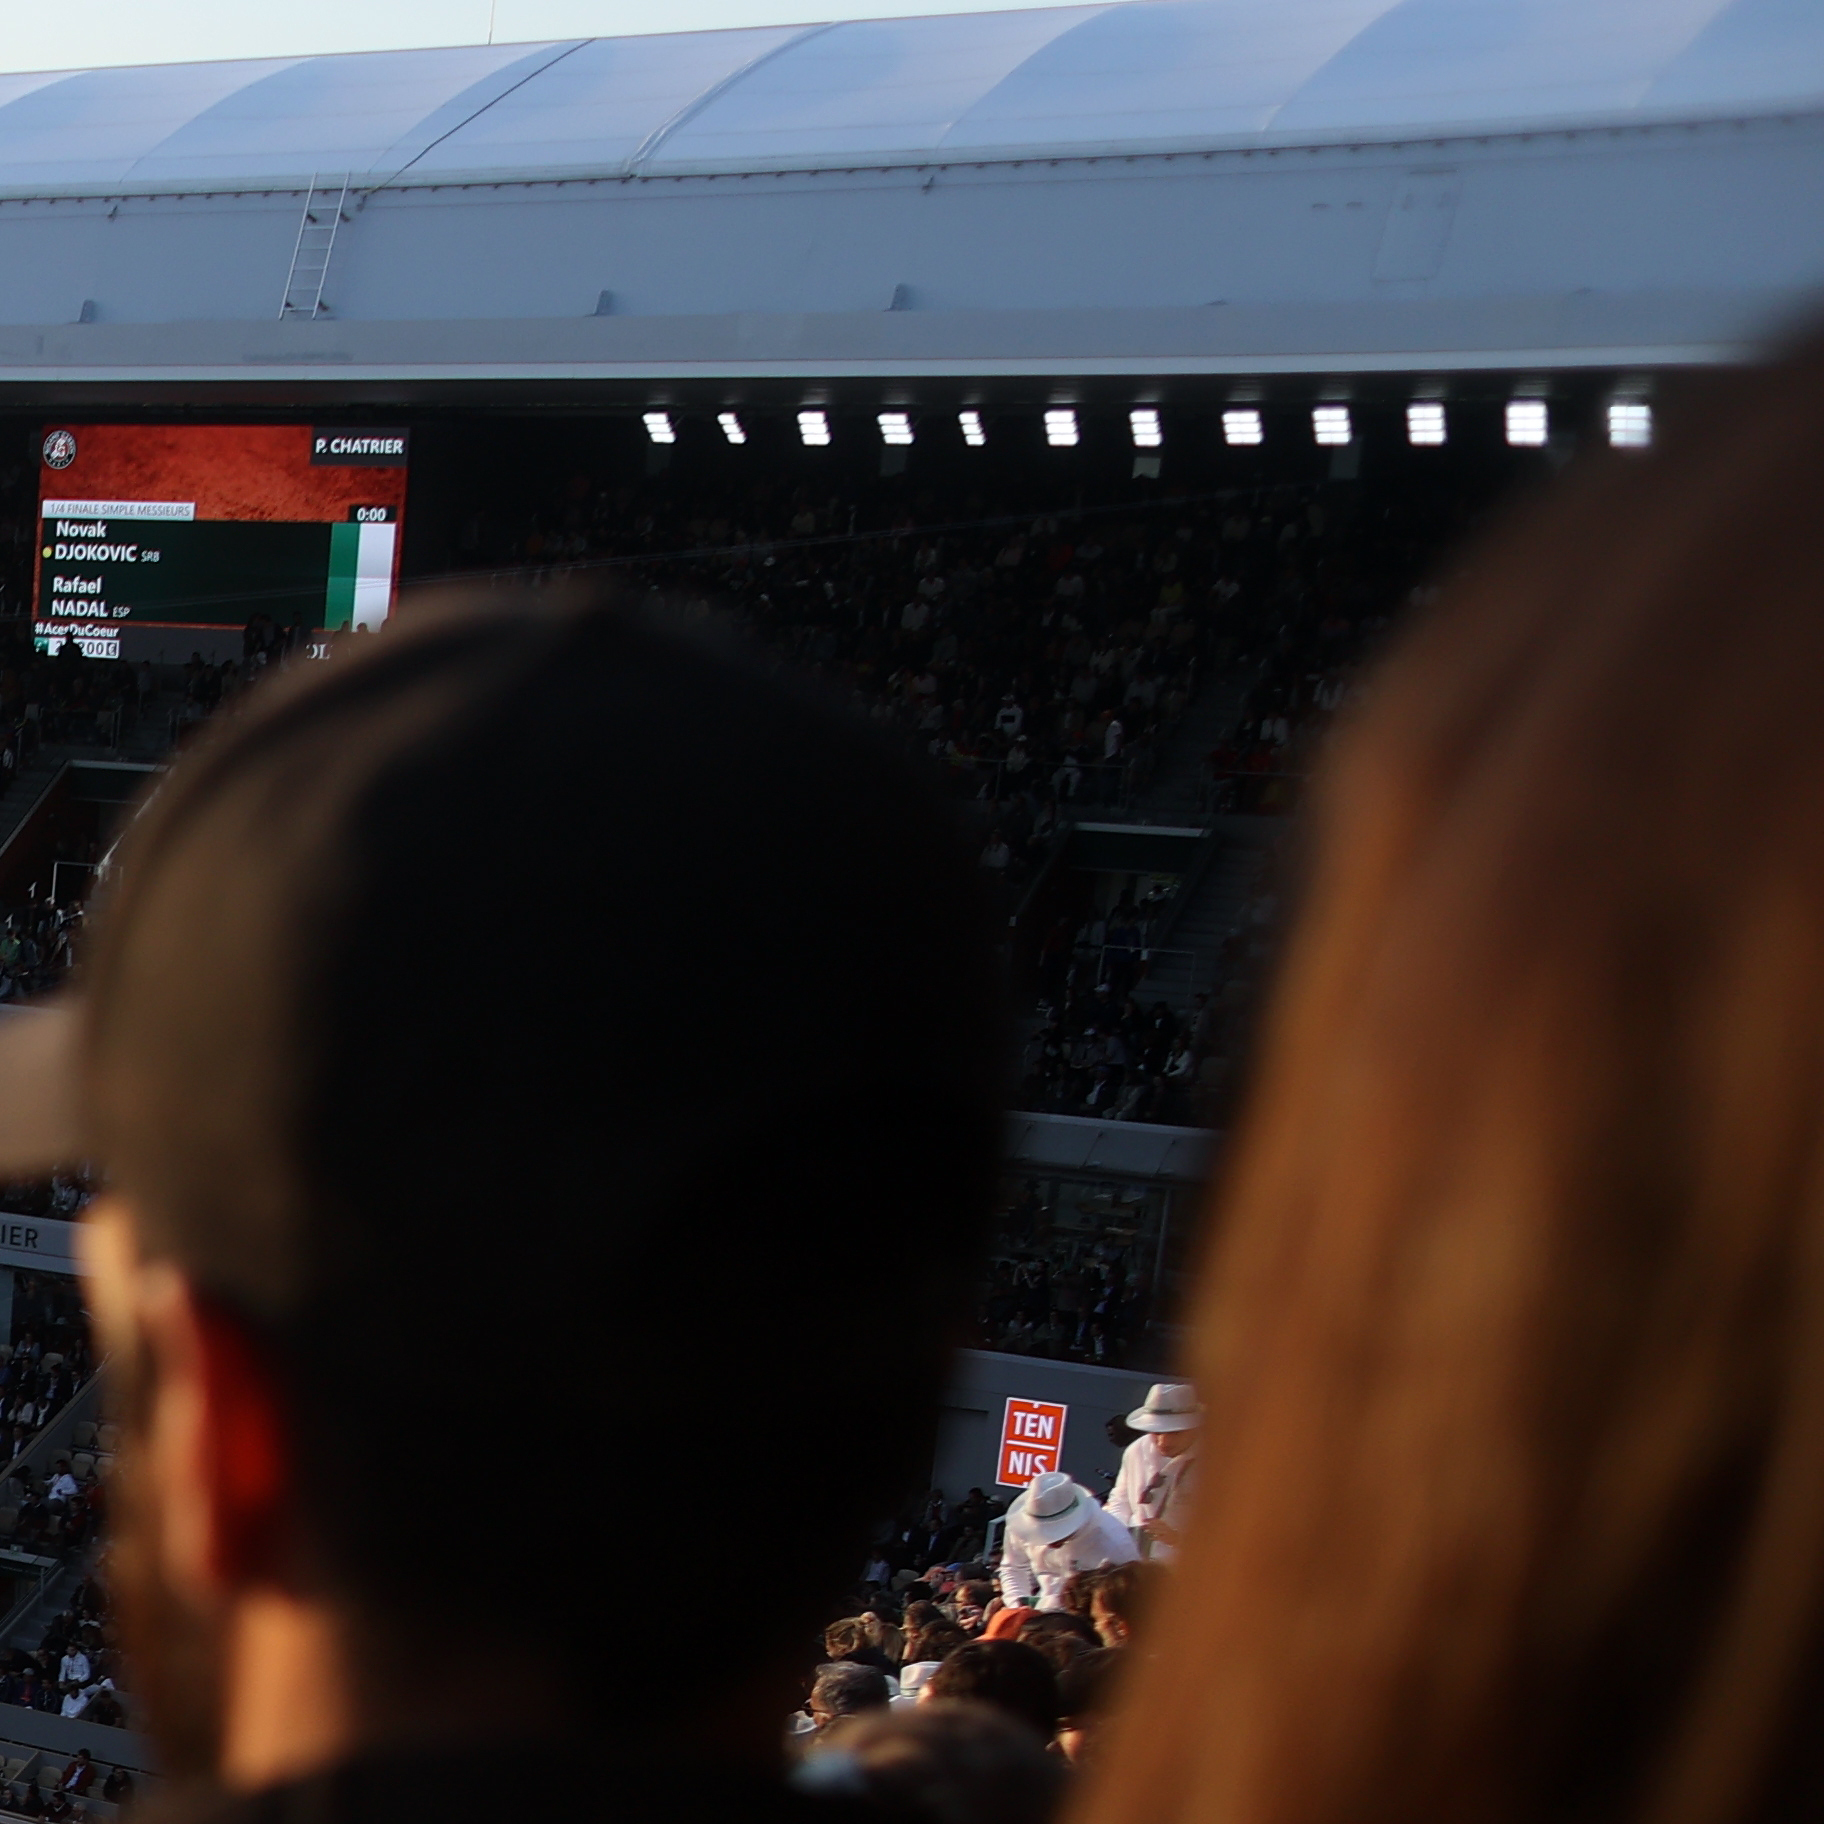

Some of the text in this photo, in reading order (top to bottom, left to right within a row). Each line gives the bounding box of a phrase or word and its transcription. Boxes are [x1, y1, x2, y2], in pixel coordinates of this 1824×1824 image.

[315, 438, 403, 454] P. CHATRIER
[51, 503, 190, 517] 1/4 FINALE SIMPLE MESSIEURS
[357, 507, 386, 521] 0:00
[56, 520, 107, 538] Novak
[54, 543, 160, 563] DJOKOVIC SRB
[52, 575, 102, 594] Rafael
[51, 599, 131, 618] NADAL ESP
[1013, 1411, 1055, 1440] TEN
[1008, 1452, 1049, 1476] NIS
